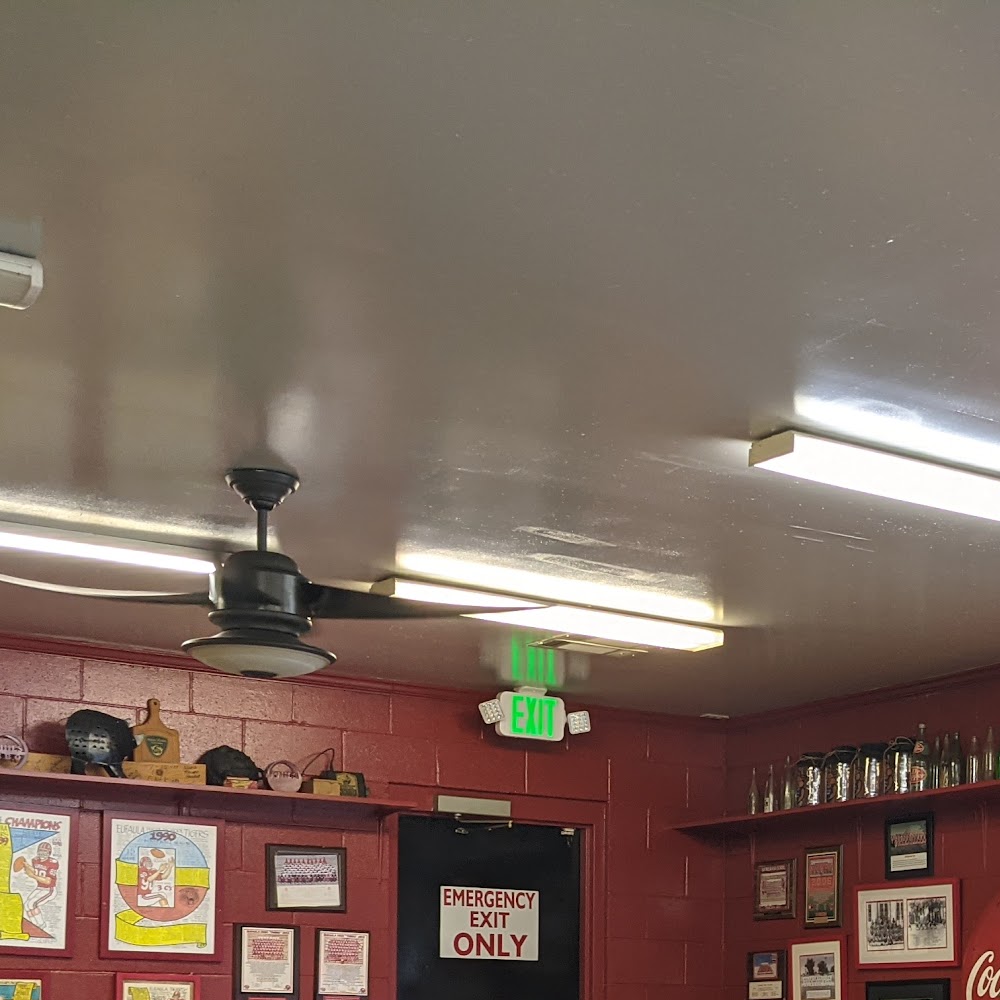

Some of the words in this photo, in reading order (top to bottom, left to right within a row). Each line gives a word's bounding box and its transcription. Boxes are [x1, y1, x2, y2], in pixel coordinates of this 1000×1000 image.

[511, 695, 558, 738] EXIT
[4, 816, 63, 831] CHAMPIONS
[149, 830, 177, 842] 1990
[443, 888, 536, 910] EMERGENCY
[469, 911, 510, 929] EXIT
[453, 932, 528, 957] ONLY
